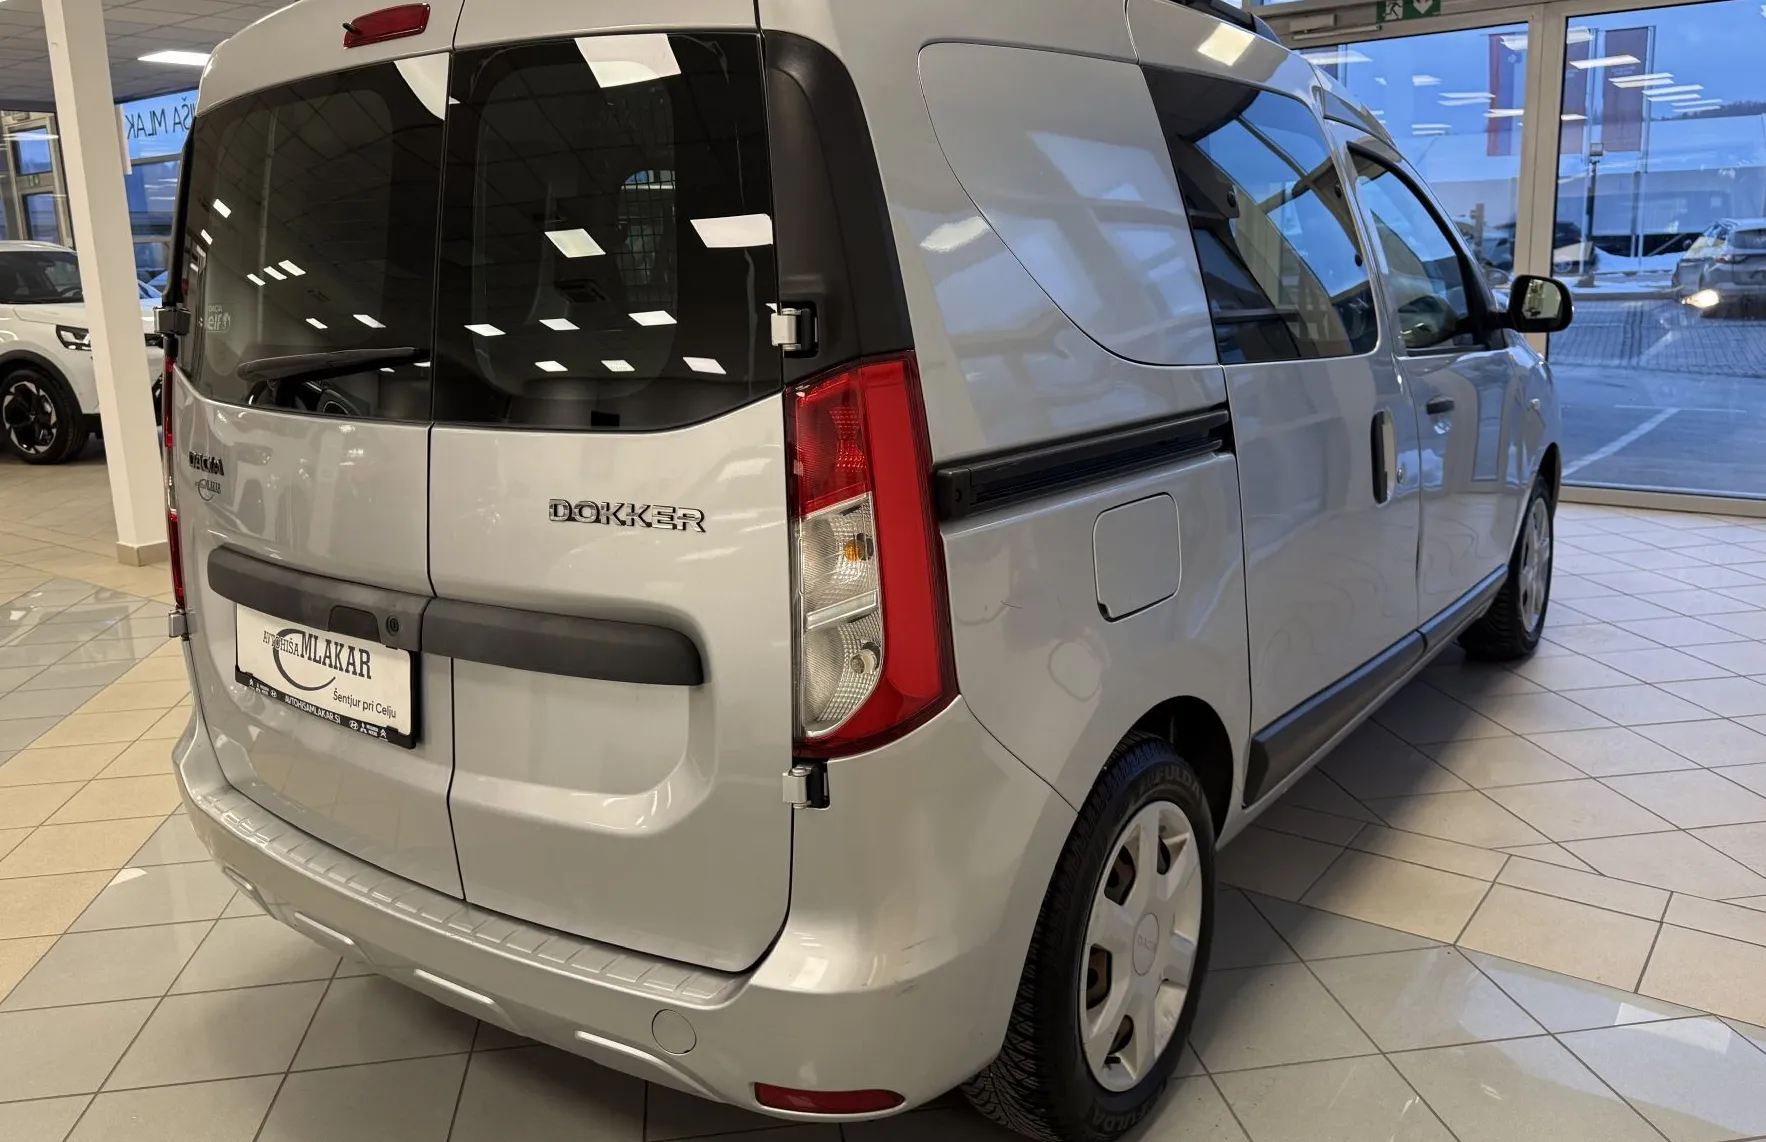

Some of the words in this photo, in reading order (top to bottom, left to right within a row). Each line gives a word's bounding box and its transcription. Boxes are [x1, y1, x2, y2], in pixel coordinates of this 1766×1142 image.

[549, 499, 706, 533] DOKKER
[300, 633, 372, 680] MLAKAR
[333, 688, 361, 708] Šentjur
[362, 700, 374, 712] pri
[375, 702, 396, 719] Celju
